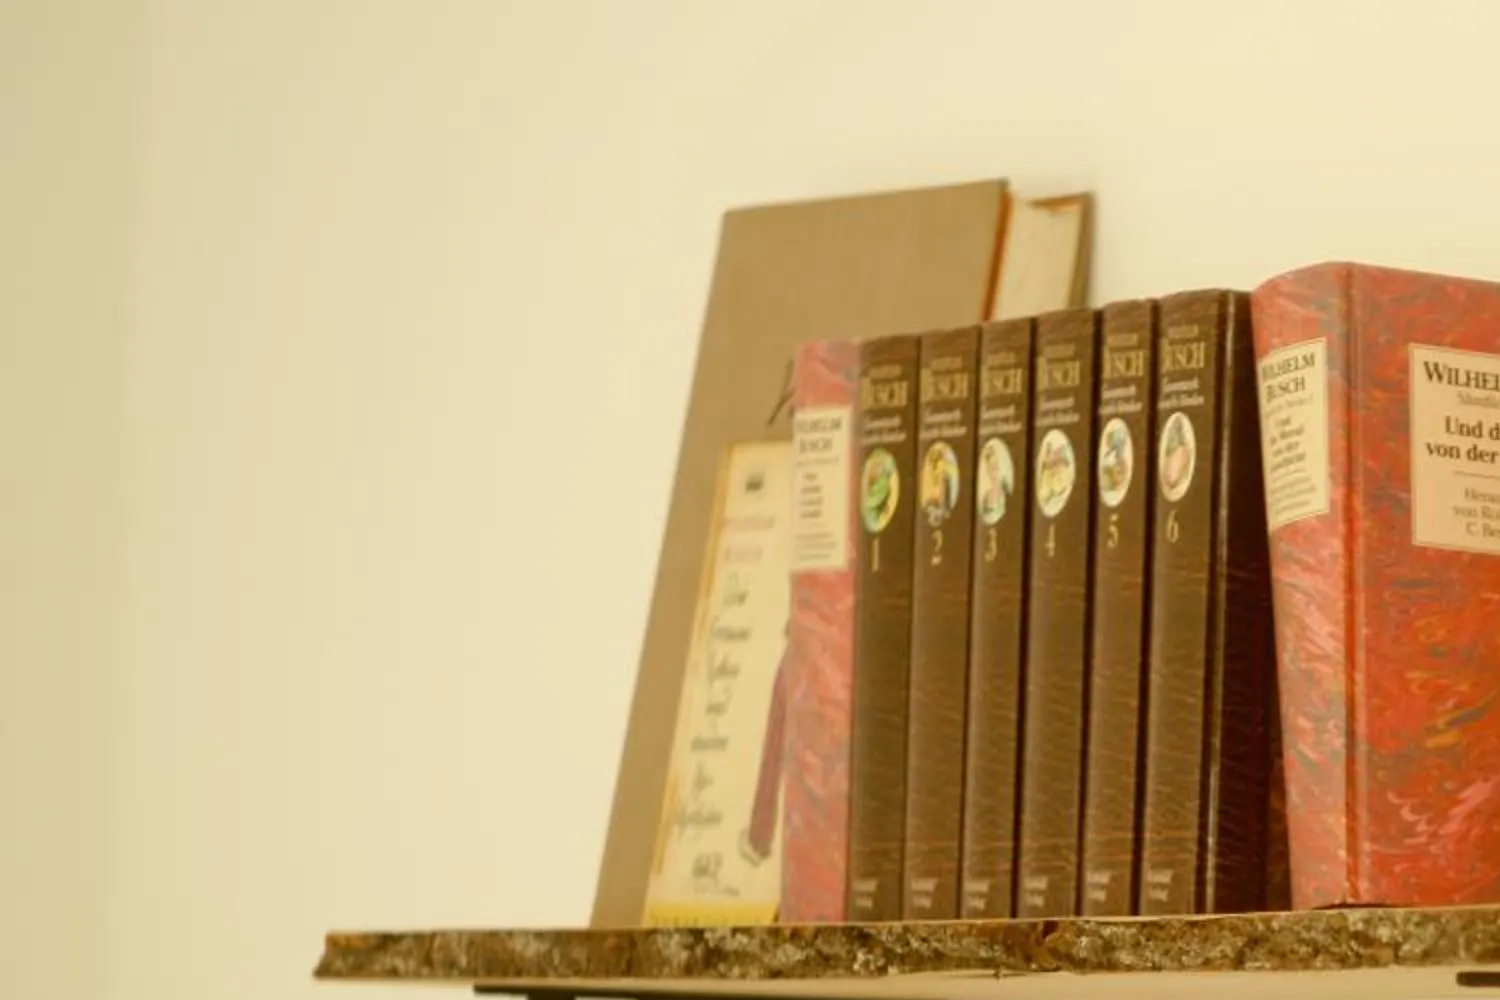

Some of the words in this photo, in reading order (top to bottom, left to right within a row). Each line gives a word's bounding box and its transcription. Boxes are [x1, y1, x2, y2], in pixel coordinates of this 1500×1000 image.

[1445, 416, 1483, 439] Und
[1425, 442, 1461, 460] von
[1467, 444, 1499, 464] der
[1045, 523, 1056, 557] 4
[1107, 514, 1119, 549] 5
[1167, 510, 1179, 543] 6
[872, 537, 880, 572] 1
[930, 530, 943, 566] 2
[985, 528, 998, 562] 3
